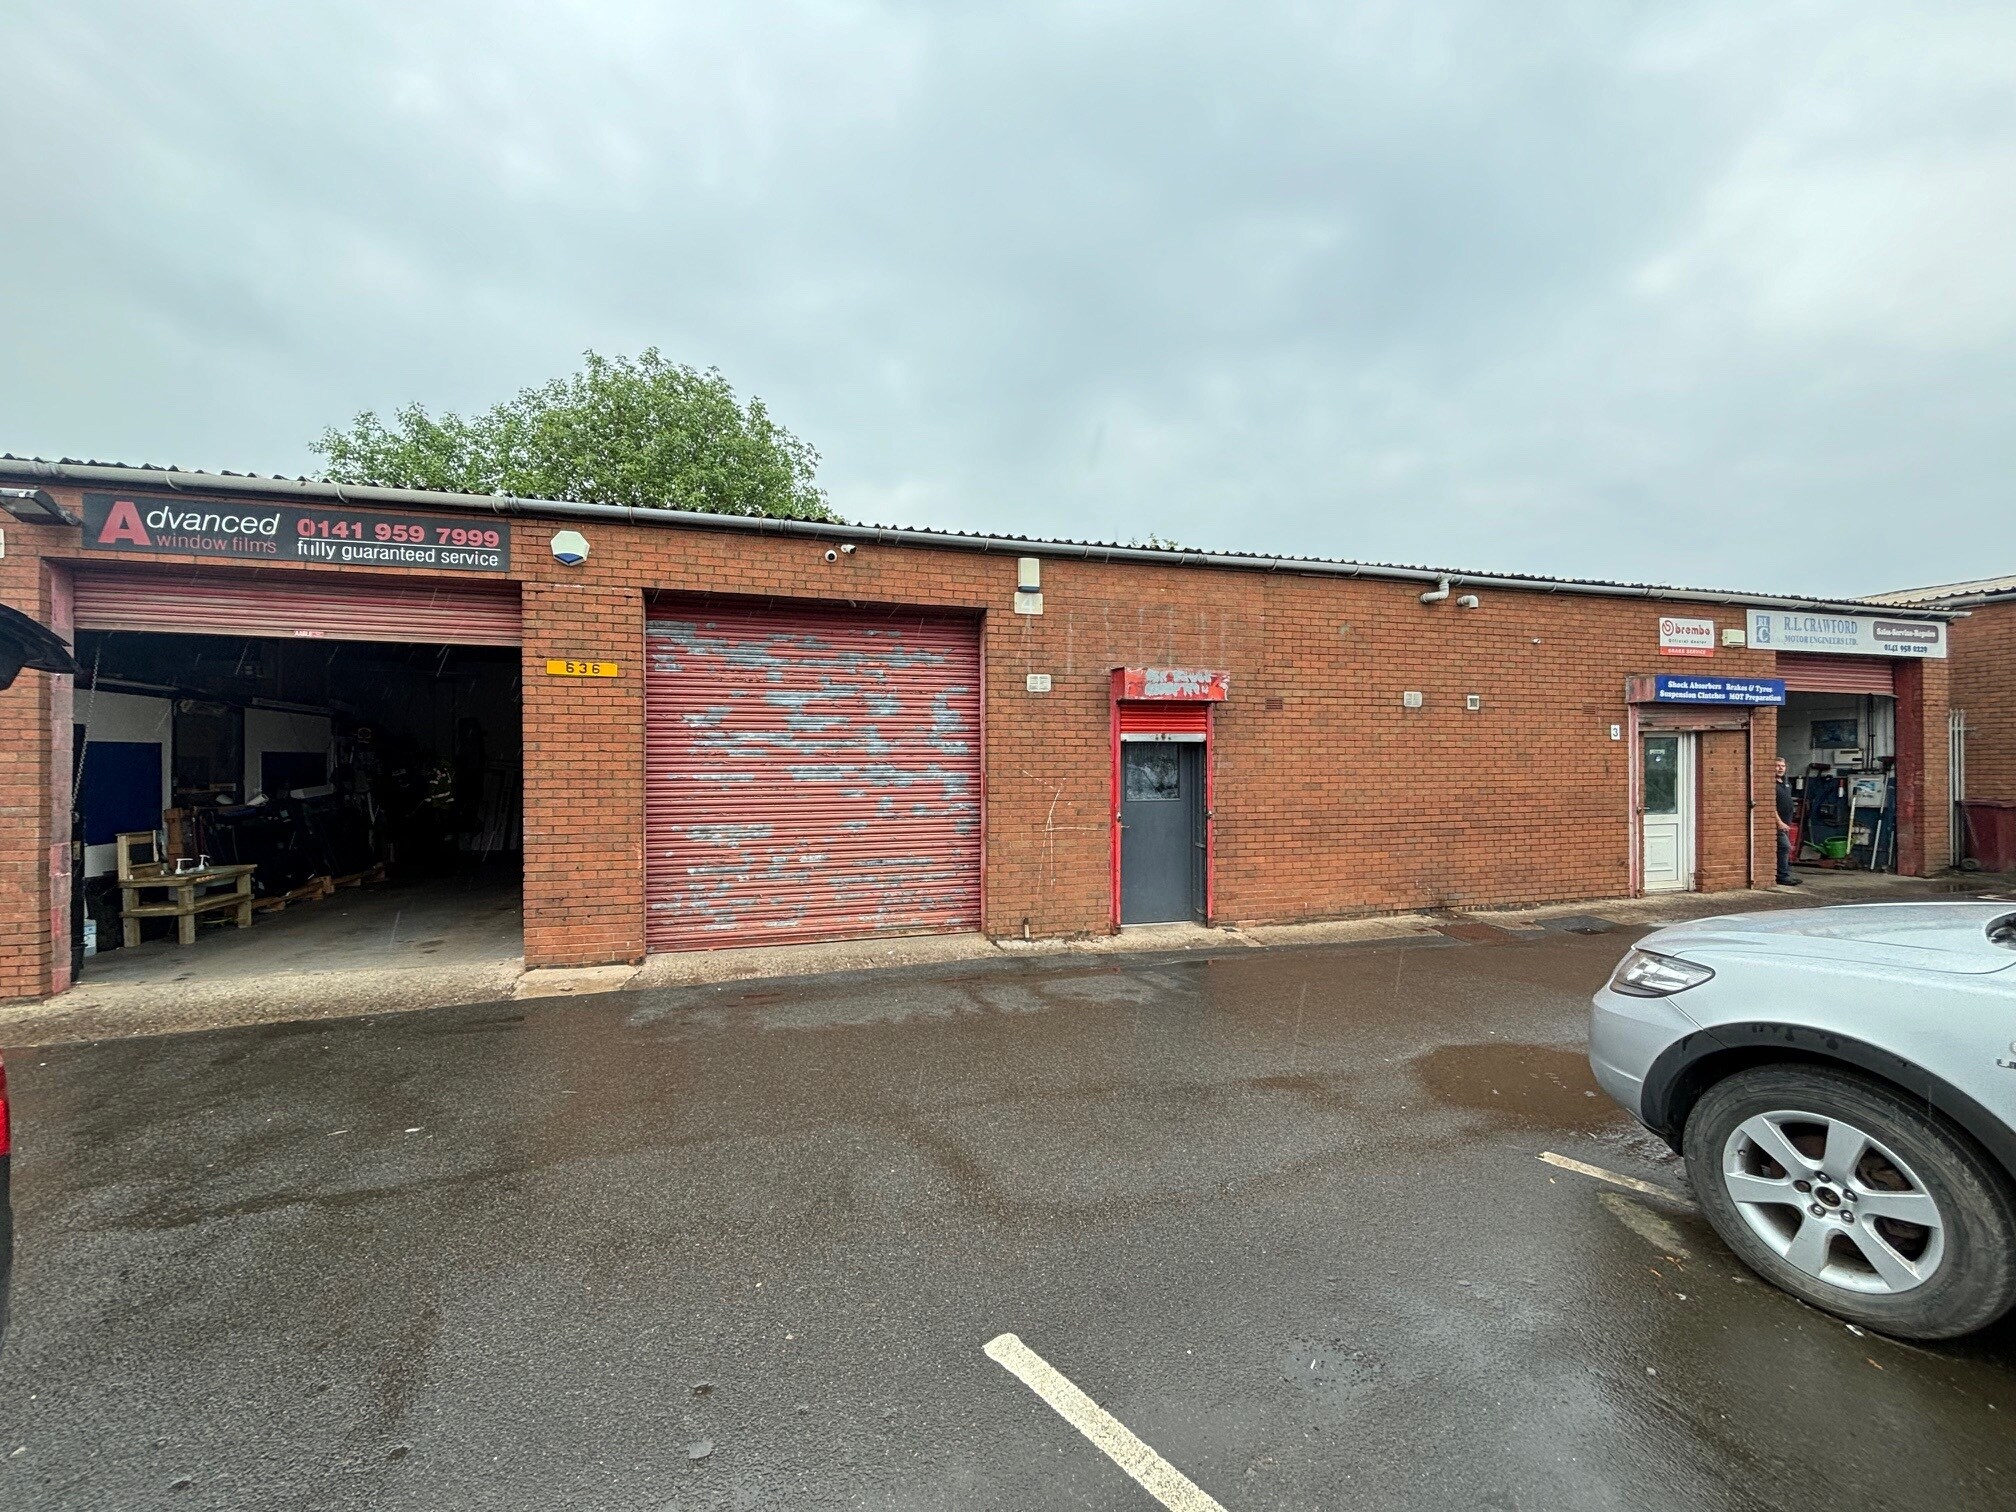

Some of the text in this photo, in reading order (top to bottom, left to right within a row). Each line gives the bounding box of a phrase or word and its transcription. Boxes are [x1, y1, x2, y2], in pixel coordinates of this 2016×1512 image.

[98, 501, 281, 546] Advanced
[297, 518, 500, 547] 0141 959 7999
[156, 533, 277, 553] window films
[297, 540, 498, 567] fully guaranteed service
[1022, 595, 1035, 611] 4
[1675, 623, 1711, 635] brembo
[1784, 616, 1858, 635] R.L. CRAWFORD
[1785, 635, 1809, 644] MOTOR
[1810, 636, 1844, 645] ENGINEERS
[1884, 644, 1898, 652] 0141
[1900, 644, 1911, 653] 958
[566, 663, 600, 674] 636
[1668, 681, 1688, 689] Shock
[1689, 682, 1721, 690] Absorbers
[1726, 683, 1747, 692] Brakes
[1755, 685, 1773, 693] Tyres
[1659, 690, 1696, 699] Suspension
[1697, 692, 1725, 700] Clutches
[1745, 694, 1782, 702] Preparation
[1613, 727, 1618, 737] 3
